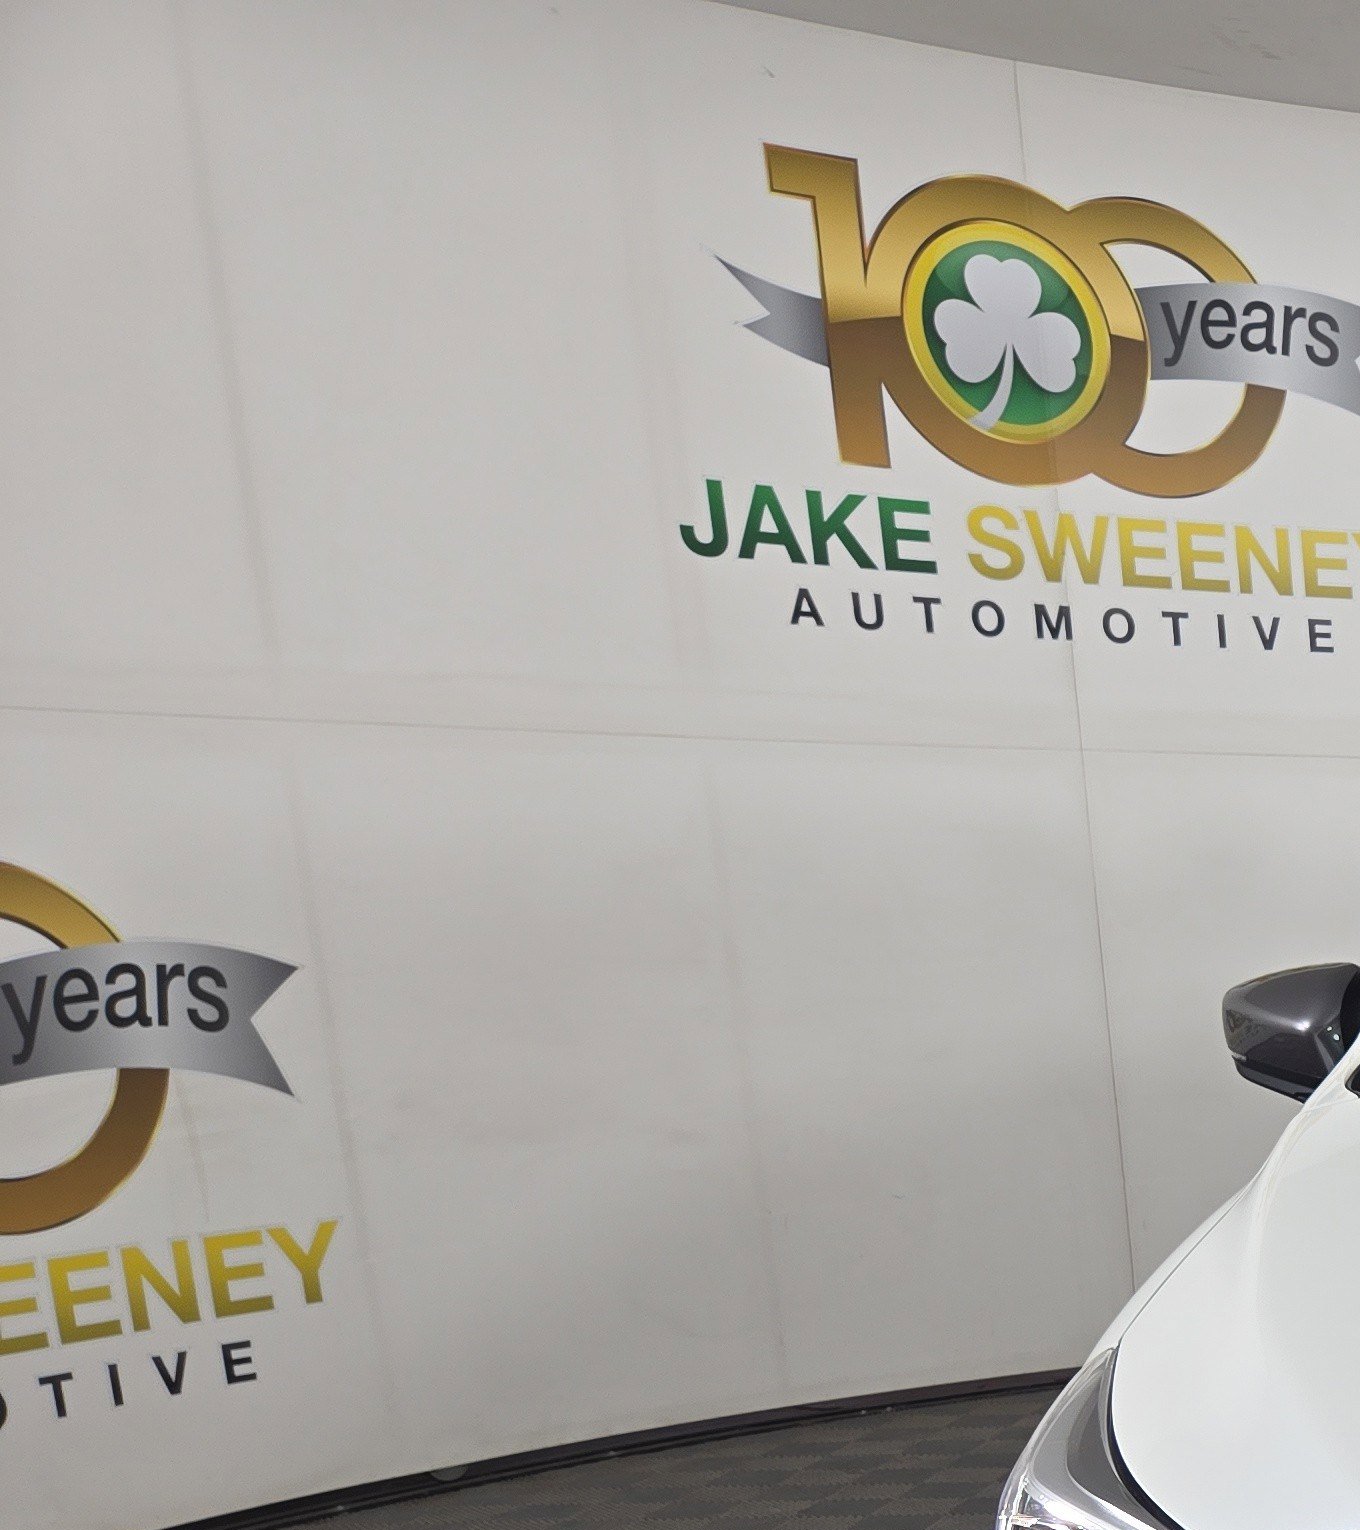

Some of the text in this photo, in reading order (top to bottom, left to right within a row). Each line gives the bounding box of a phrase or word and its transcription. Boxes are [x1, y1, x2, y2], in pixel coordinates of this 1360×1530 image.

[763, 142, 1342, 498] 100 years
[679, 478, 939, 575] JAKE
[790, 588, 1335, 654] AUTOMOTIVE
[1, 961, 231, 1065] years
[0, 1340, 257, 1432] TIVE
